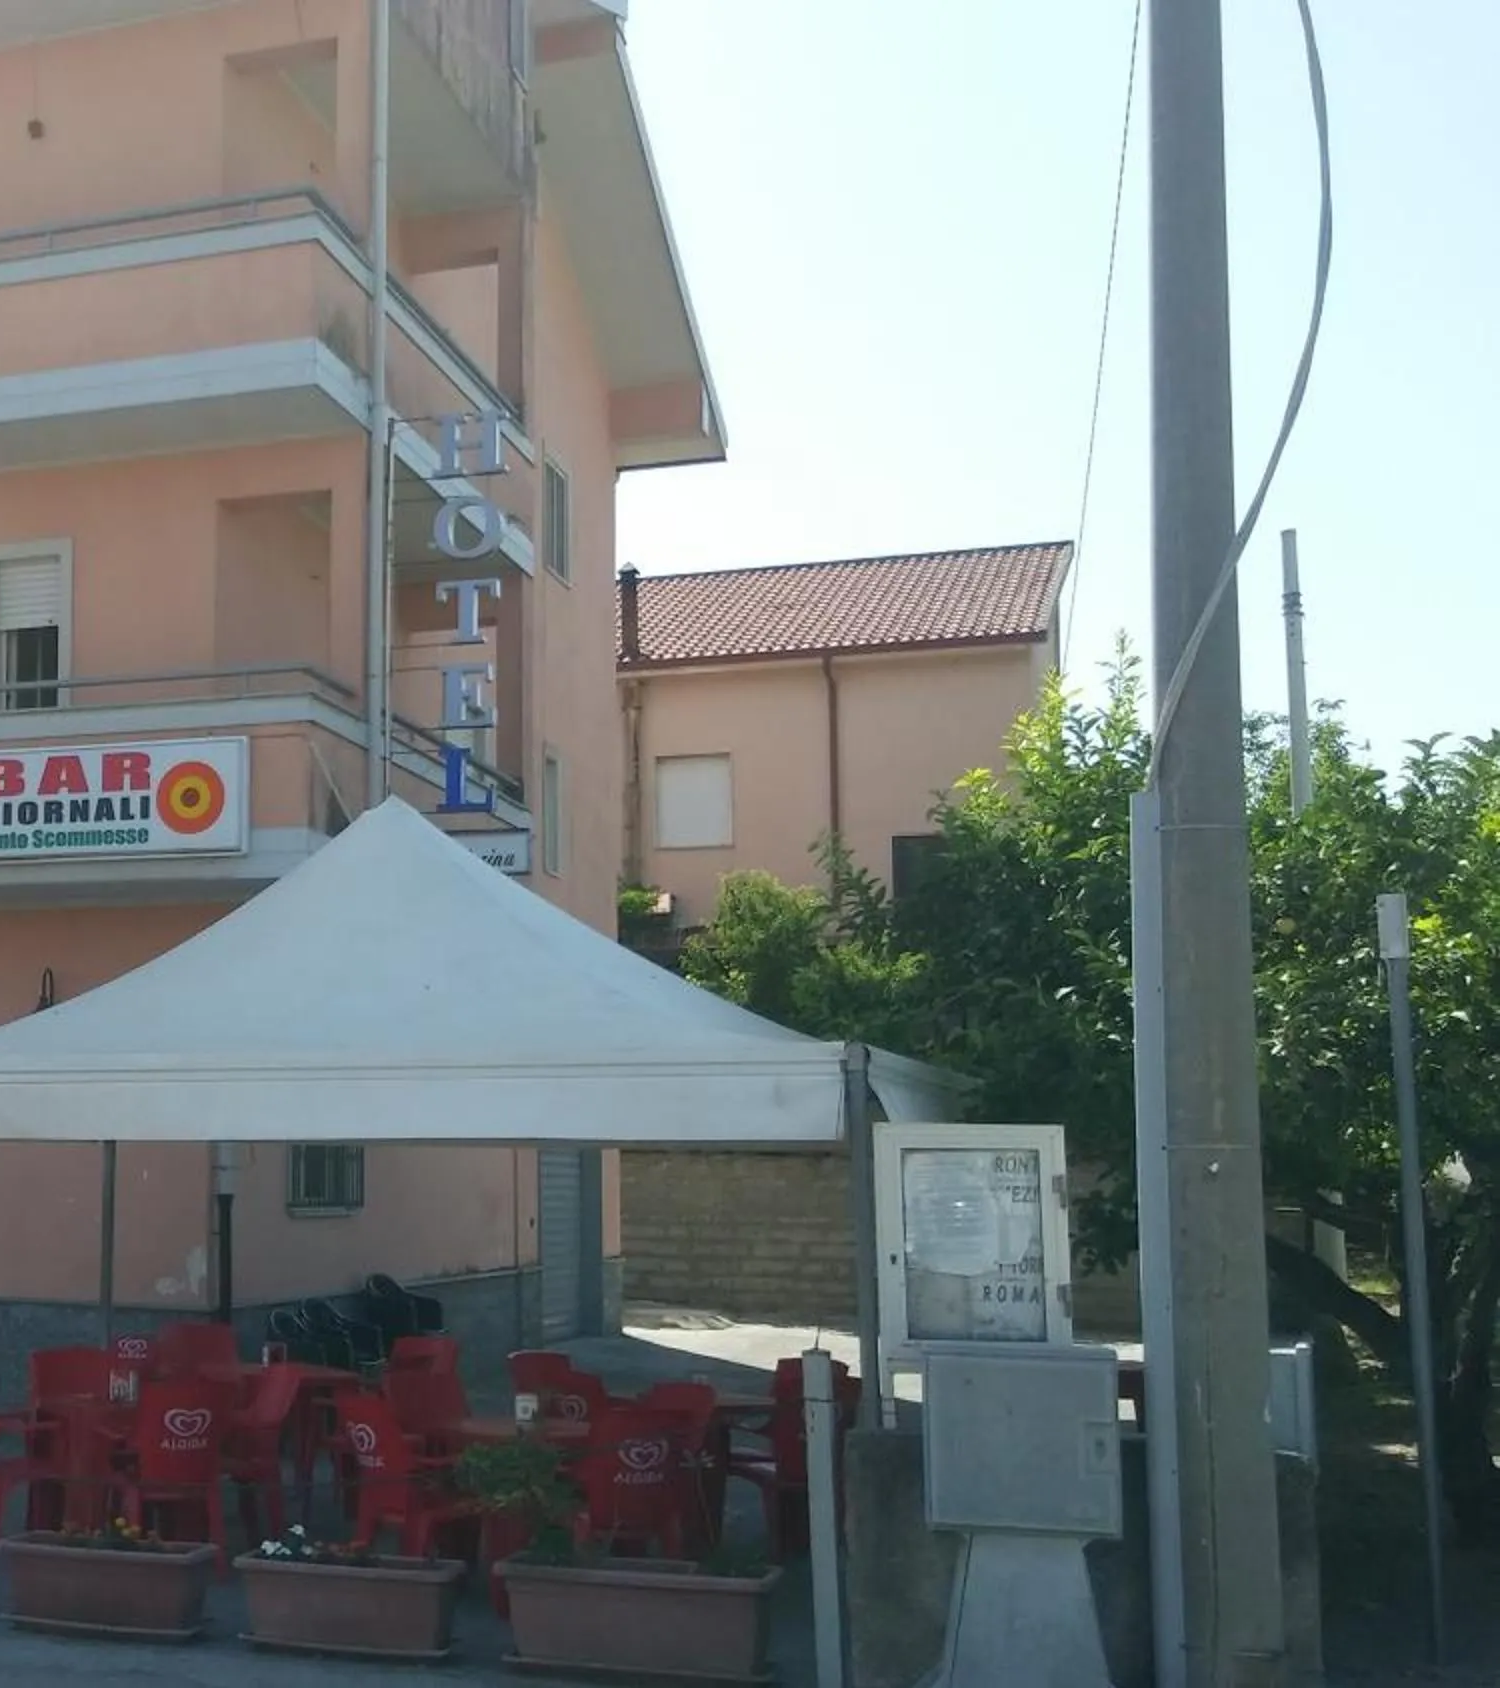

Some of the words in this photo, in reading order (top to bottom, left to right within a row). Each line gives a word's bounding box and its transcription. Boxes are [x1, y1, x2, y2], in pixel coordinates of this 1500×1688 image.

[432, 410, 511, 813] HOTEL
[32, 828, 149, 849] Scommesse
[982, 1284, 1040, 1304] ROMA
